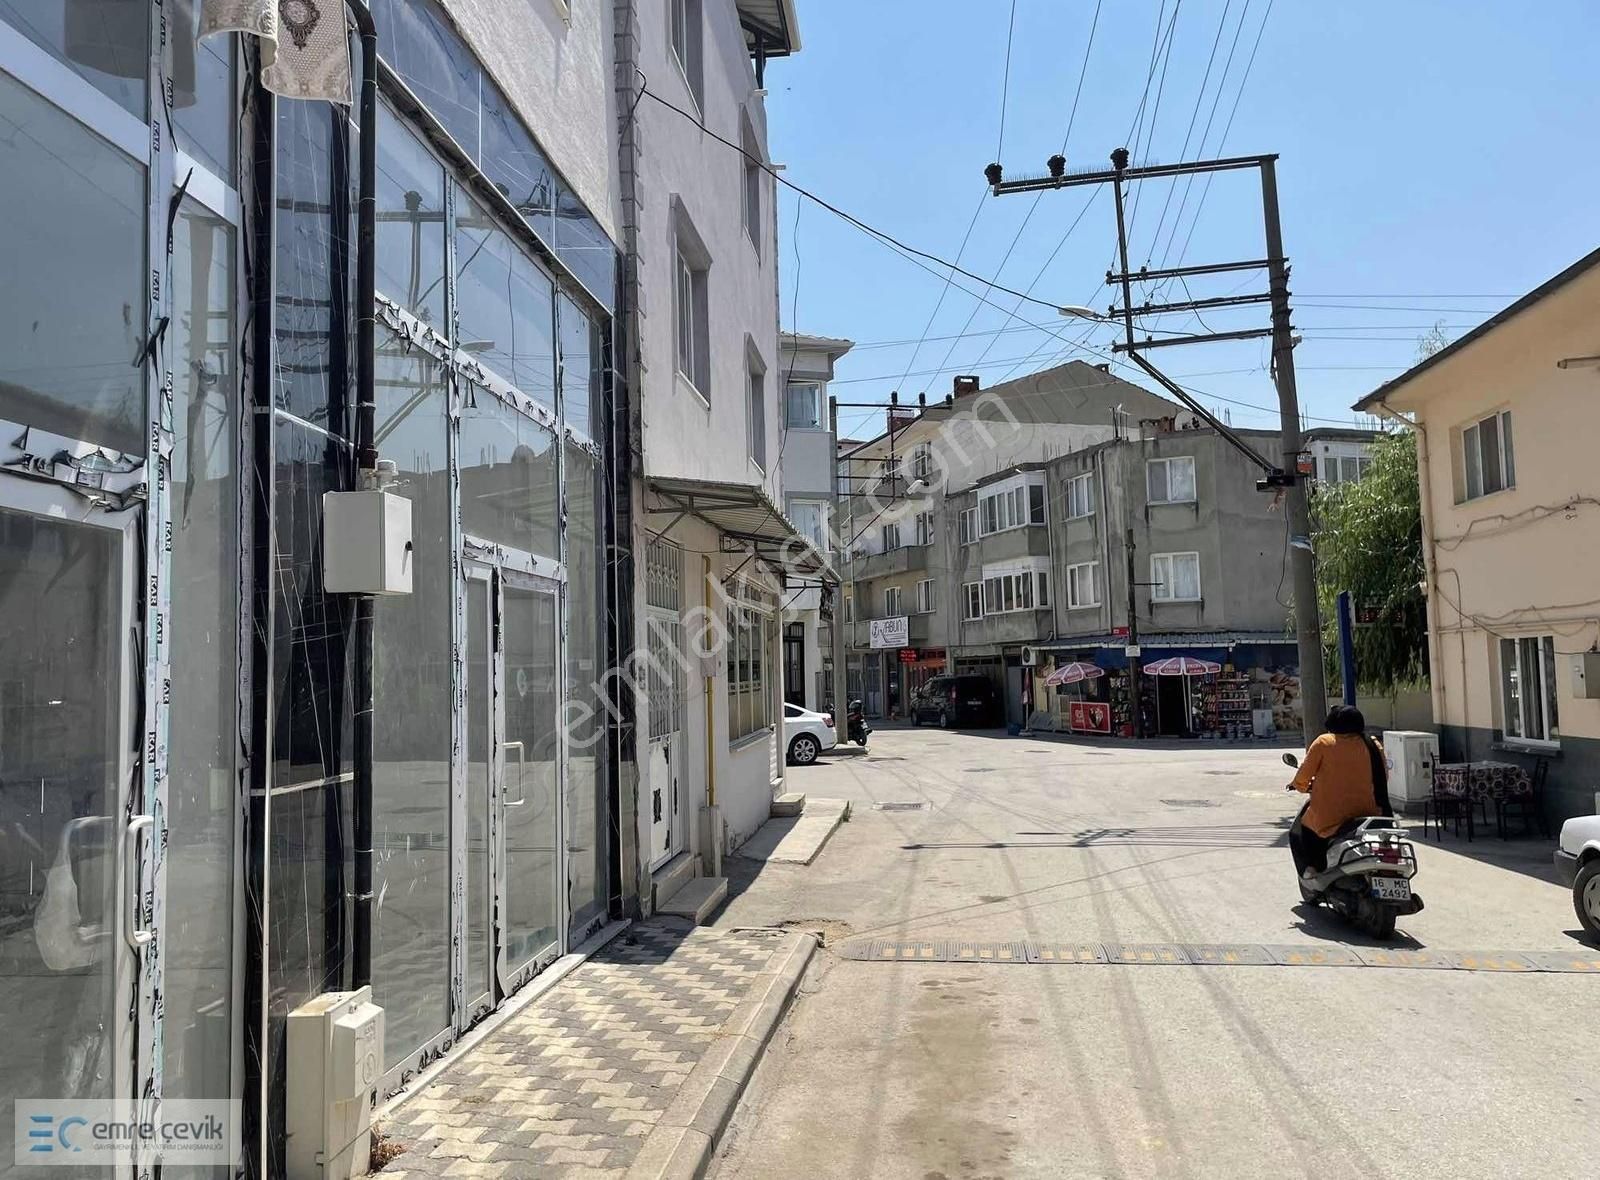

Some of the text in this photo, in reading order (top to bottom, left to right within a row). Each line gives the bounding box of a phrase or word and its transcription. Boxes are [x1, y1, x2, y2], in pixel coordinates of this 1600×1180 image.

[148, 731, 156, 763] KAR
[1374, 879, 1407, 888] 16 MC
[1382, 889, 1408, 898] 2492
